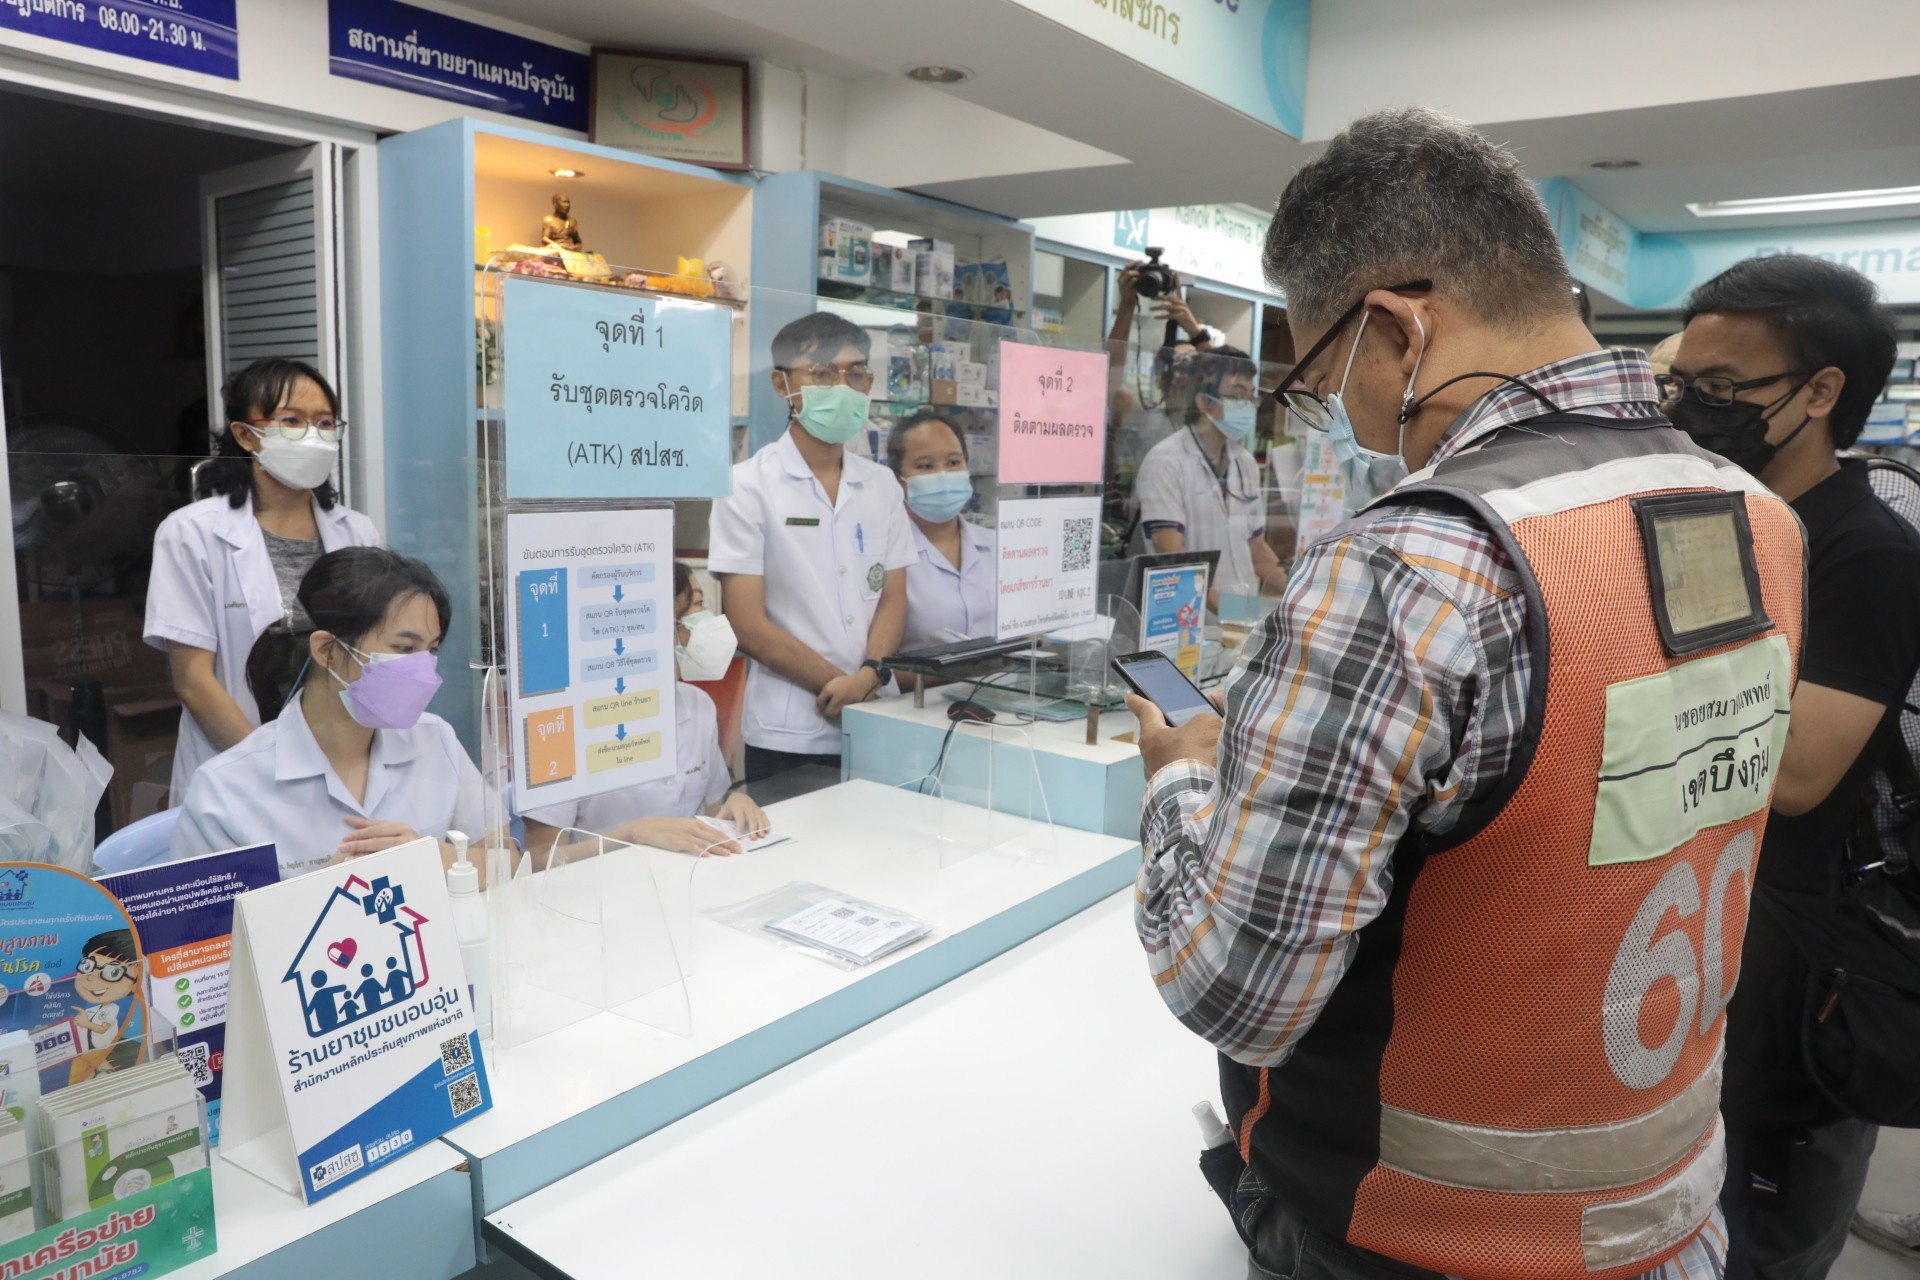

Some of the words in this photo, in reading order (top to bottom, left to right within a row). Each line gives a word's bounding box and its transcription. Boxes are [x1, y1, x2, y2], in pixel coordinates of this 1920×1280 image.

[348, 28, 575, 105] สถานที่ขายยาแผนปัจจุบัน
[595, 308, 646, 353] จุดที่
[655, 325, 664, 349] 1
[550, 373, 704, 413] รับชุดตรวจโควิด
[1038, 366, 1063, 396] จุดที่
[1066, 376, 1074, 393] 2
[1013, 411, 1094, 438] ติดตามผลตรวจ
[567, 441, 623, 469] (ATK)
[630, 441, 689, 468] สปสช.
[529, 571, 558, 602] จุดที่
[541, 623, 549, 637] 1
[537, 710, 565, 742] จุดที่
[549, 761, 558, 776] 2
[0, 932, 59, 956] สุขภาพ
[1602, 829, 1755, 1091] 60
[288, 986, 459, 1074] ร้านยาชุมชนอบอุ่น
[293, 1009, 464, 1093] สำนักงานหลักประกันสุขภาพแห่งชาติ
